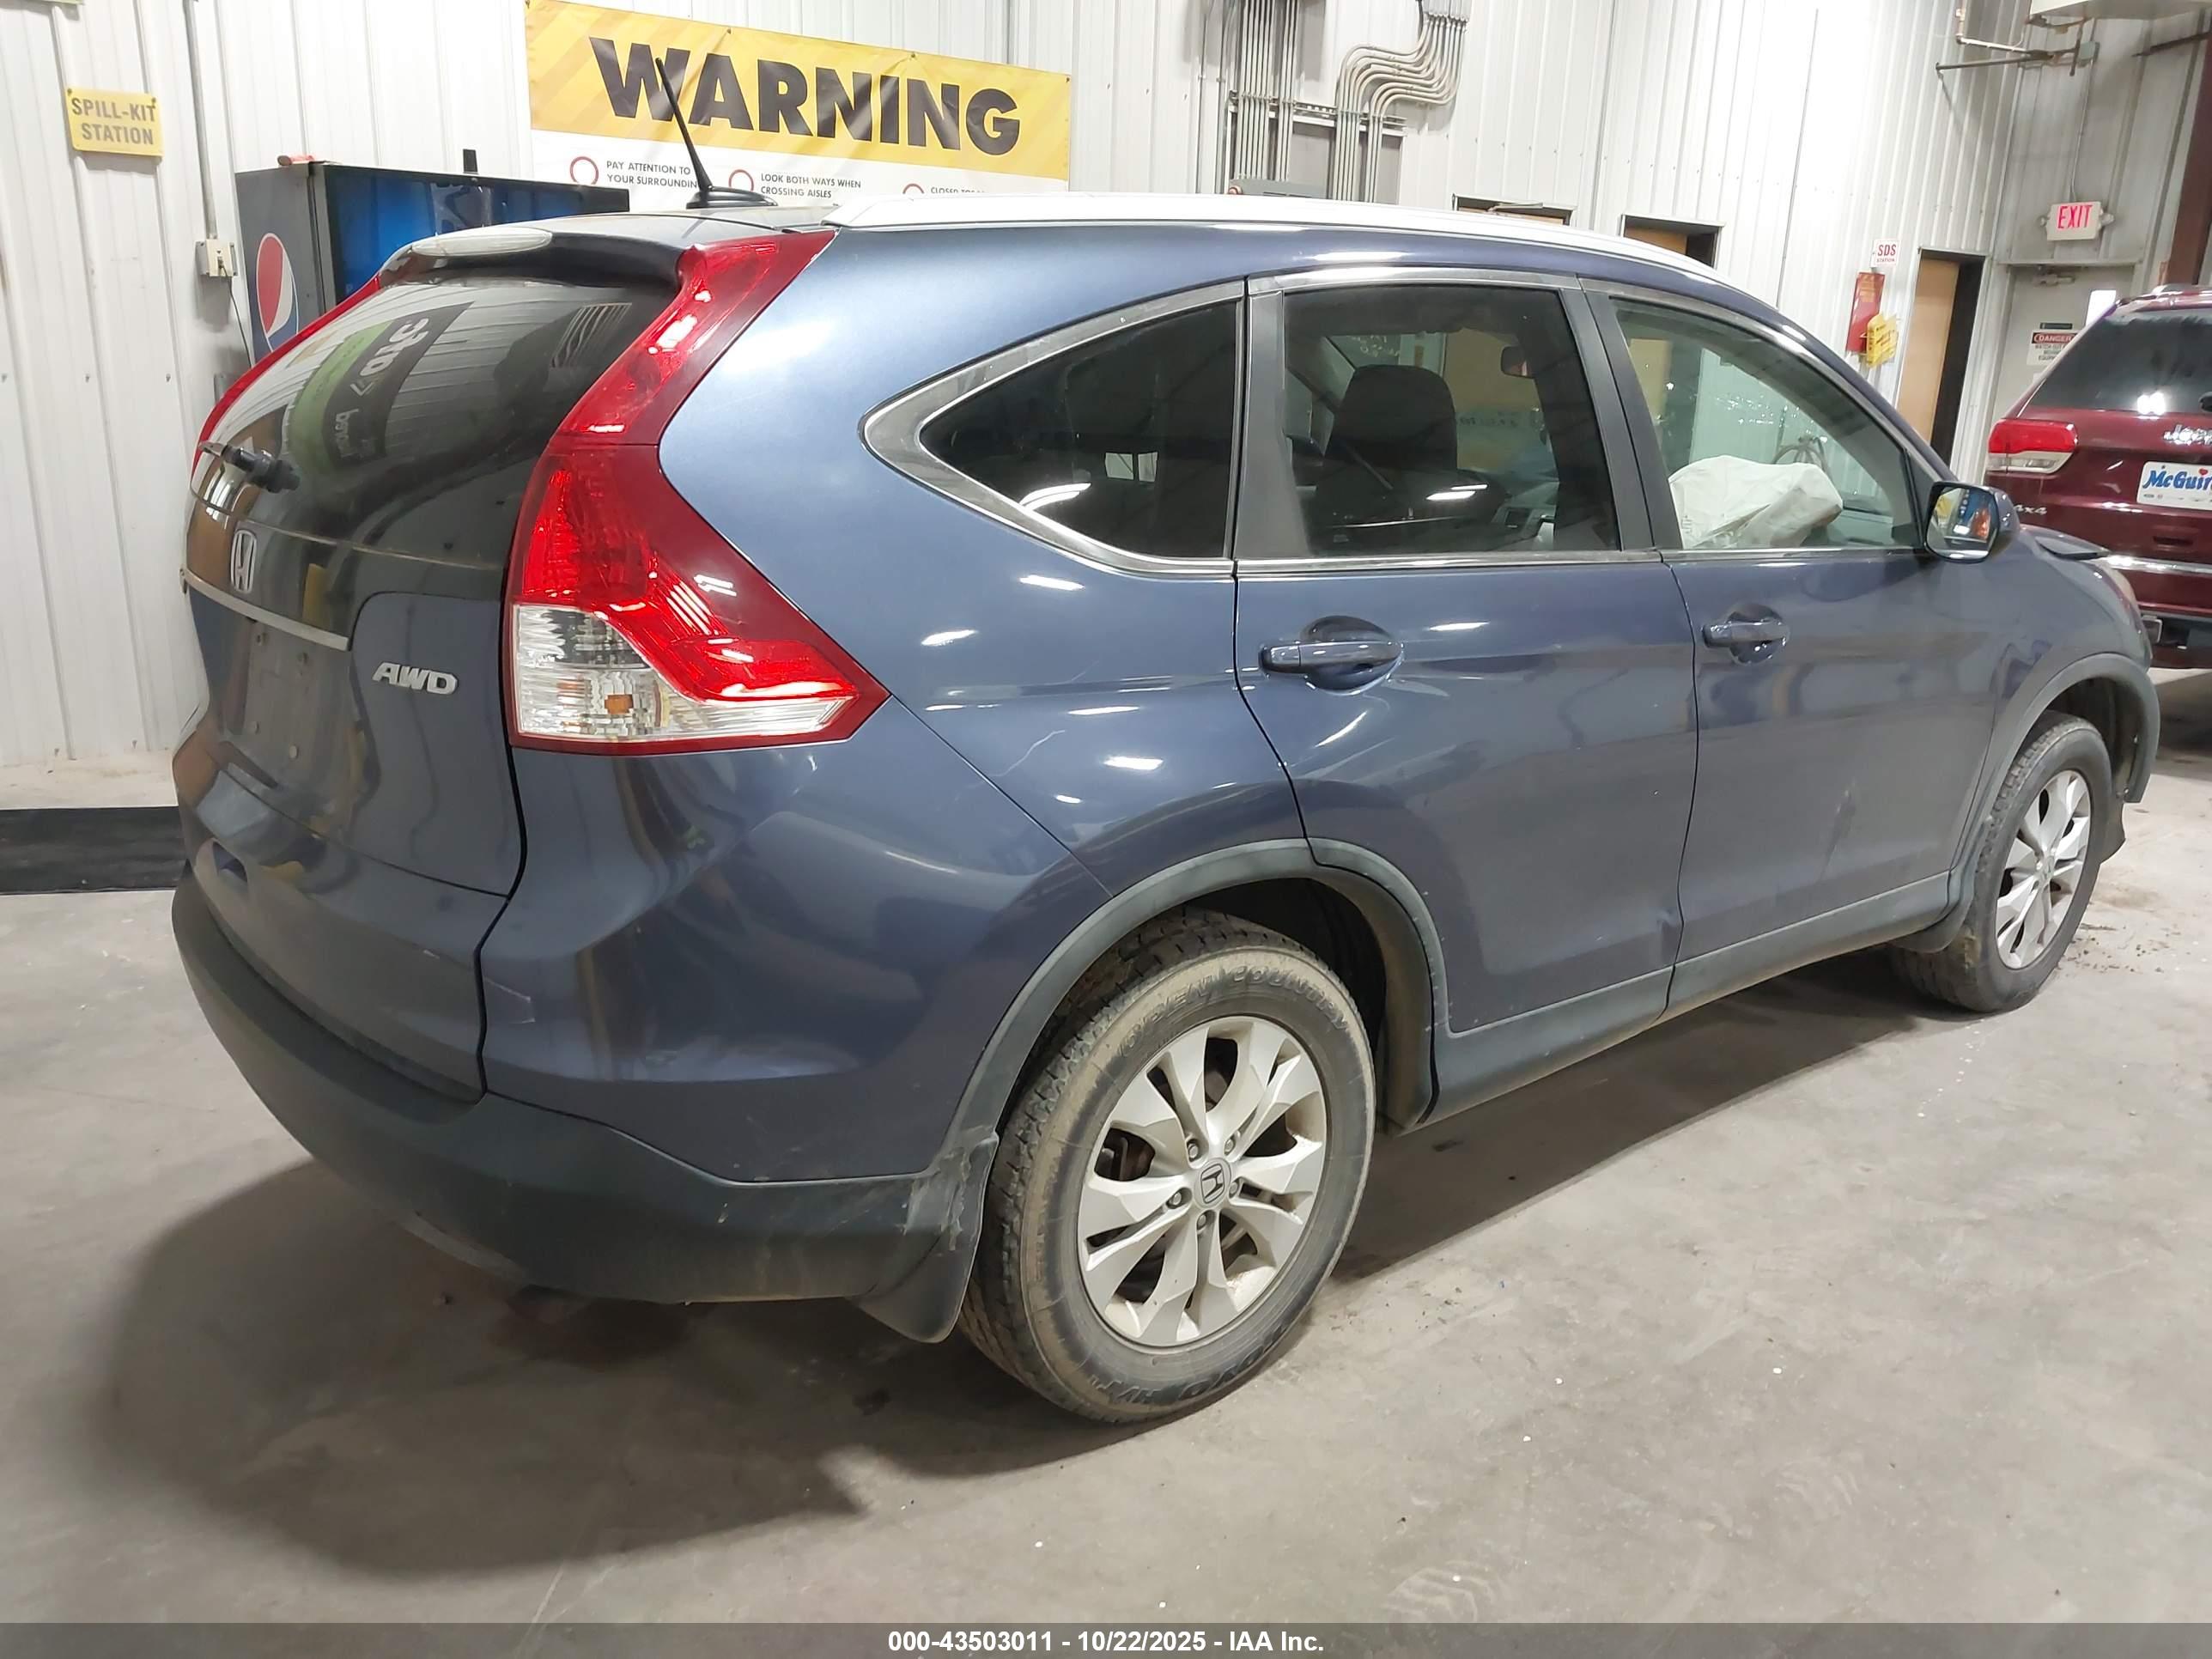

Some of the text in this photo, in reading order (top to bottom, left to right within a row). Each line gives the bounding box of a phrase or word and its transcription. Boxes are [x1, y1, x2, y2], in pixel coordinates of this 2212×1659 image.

[589, 36, 1020, 155] WARNING
[71, 97, 156, 122] SPILL-KIT
[82, 123, 154, 145] STATION
[606, 161, 691, 175] PAY ATTENTION TO
[607, 173, 697, 188] YOUR SURROUNDIN
[761, 173, 861, 189] LOOK BOTH WAYS WHEN
[761, 185, 832, 198] CROSSING AISLES
[2057, 204, 2094, 229] EXIT
[1877, 244, 1897, 257] SDS
[2142, 470, 2212, 491] McGuir
[372, 661, 459, 695] AWD
[1119, 976, 1213, 1057] OPEN
